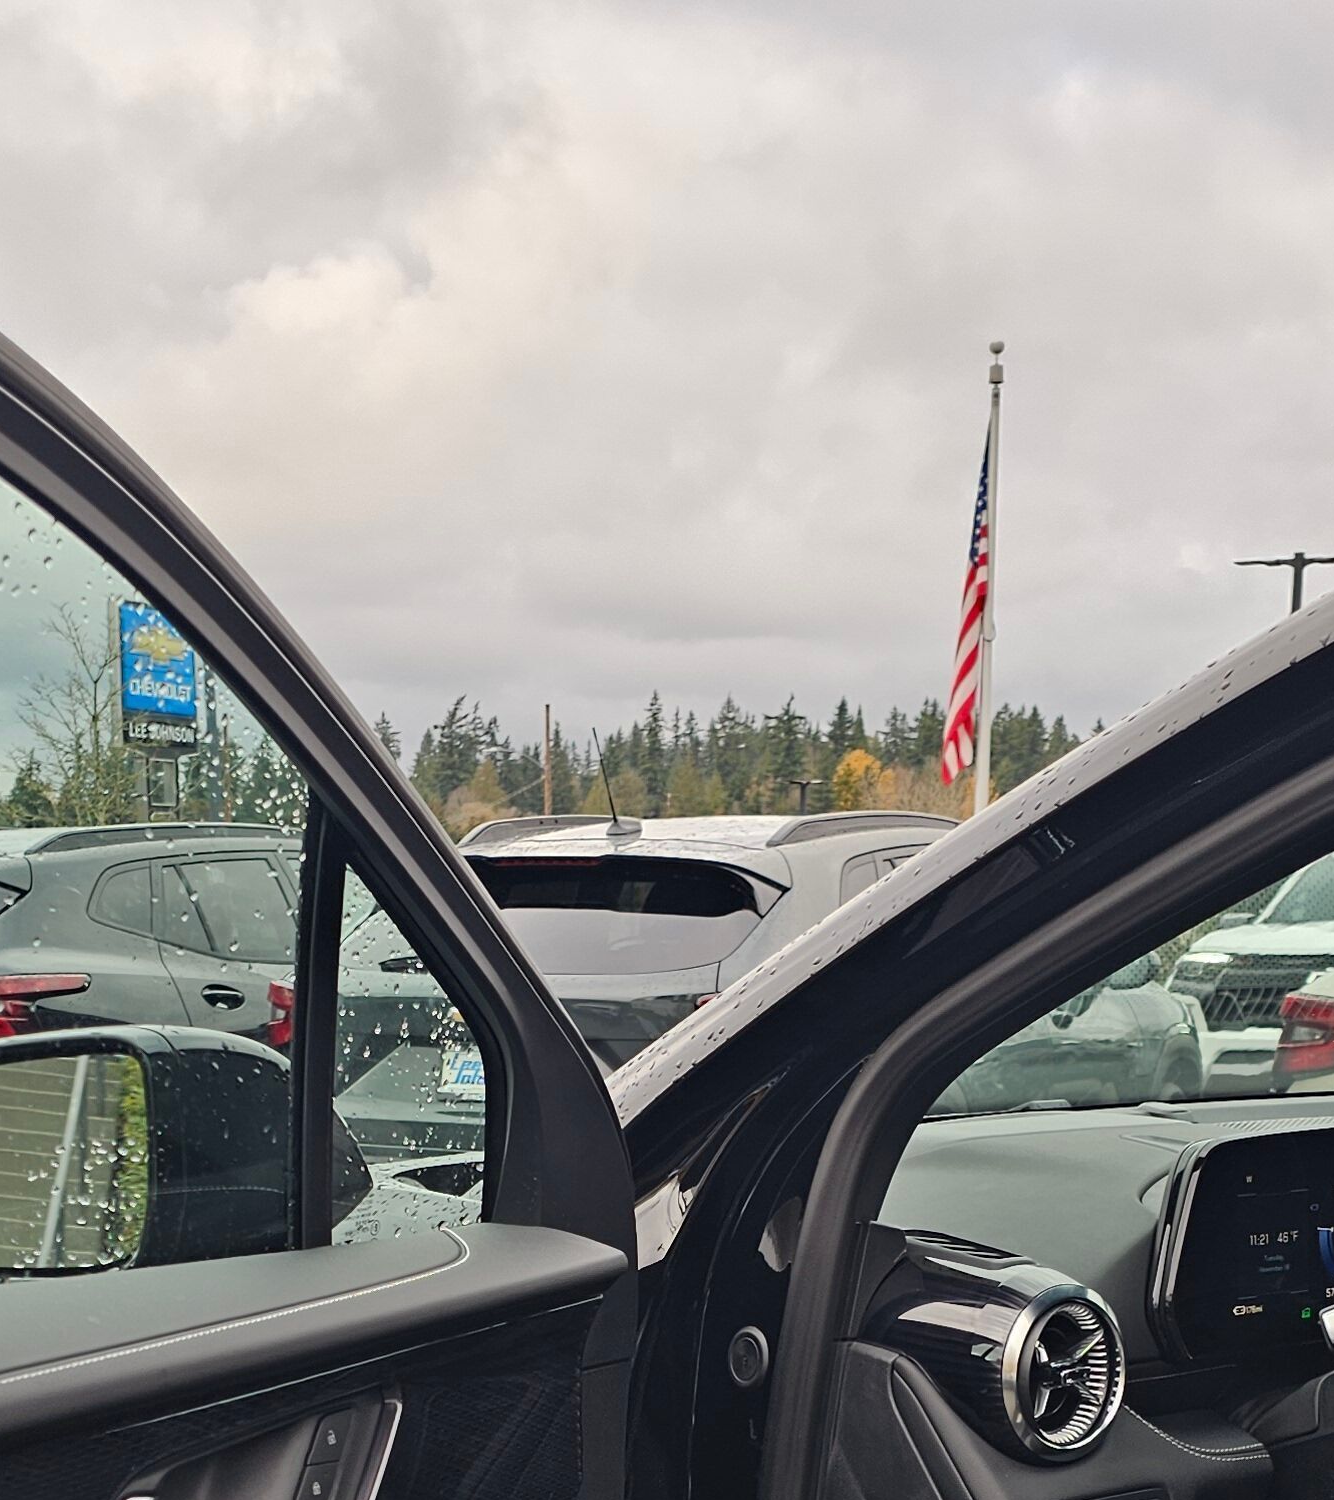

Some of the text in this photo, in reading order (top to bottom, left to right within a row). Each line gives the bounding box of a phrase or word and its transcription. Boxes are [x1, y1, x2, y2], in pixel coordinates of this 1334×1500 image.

[129, 678, 192, 703] CHEVROLET
[128, 722, 195, 743] LEE JOHNSON
[1249, 1233, 1269, 1246] 11:21
